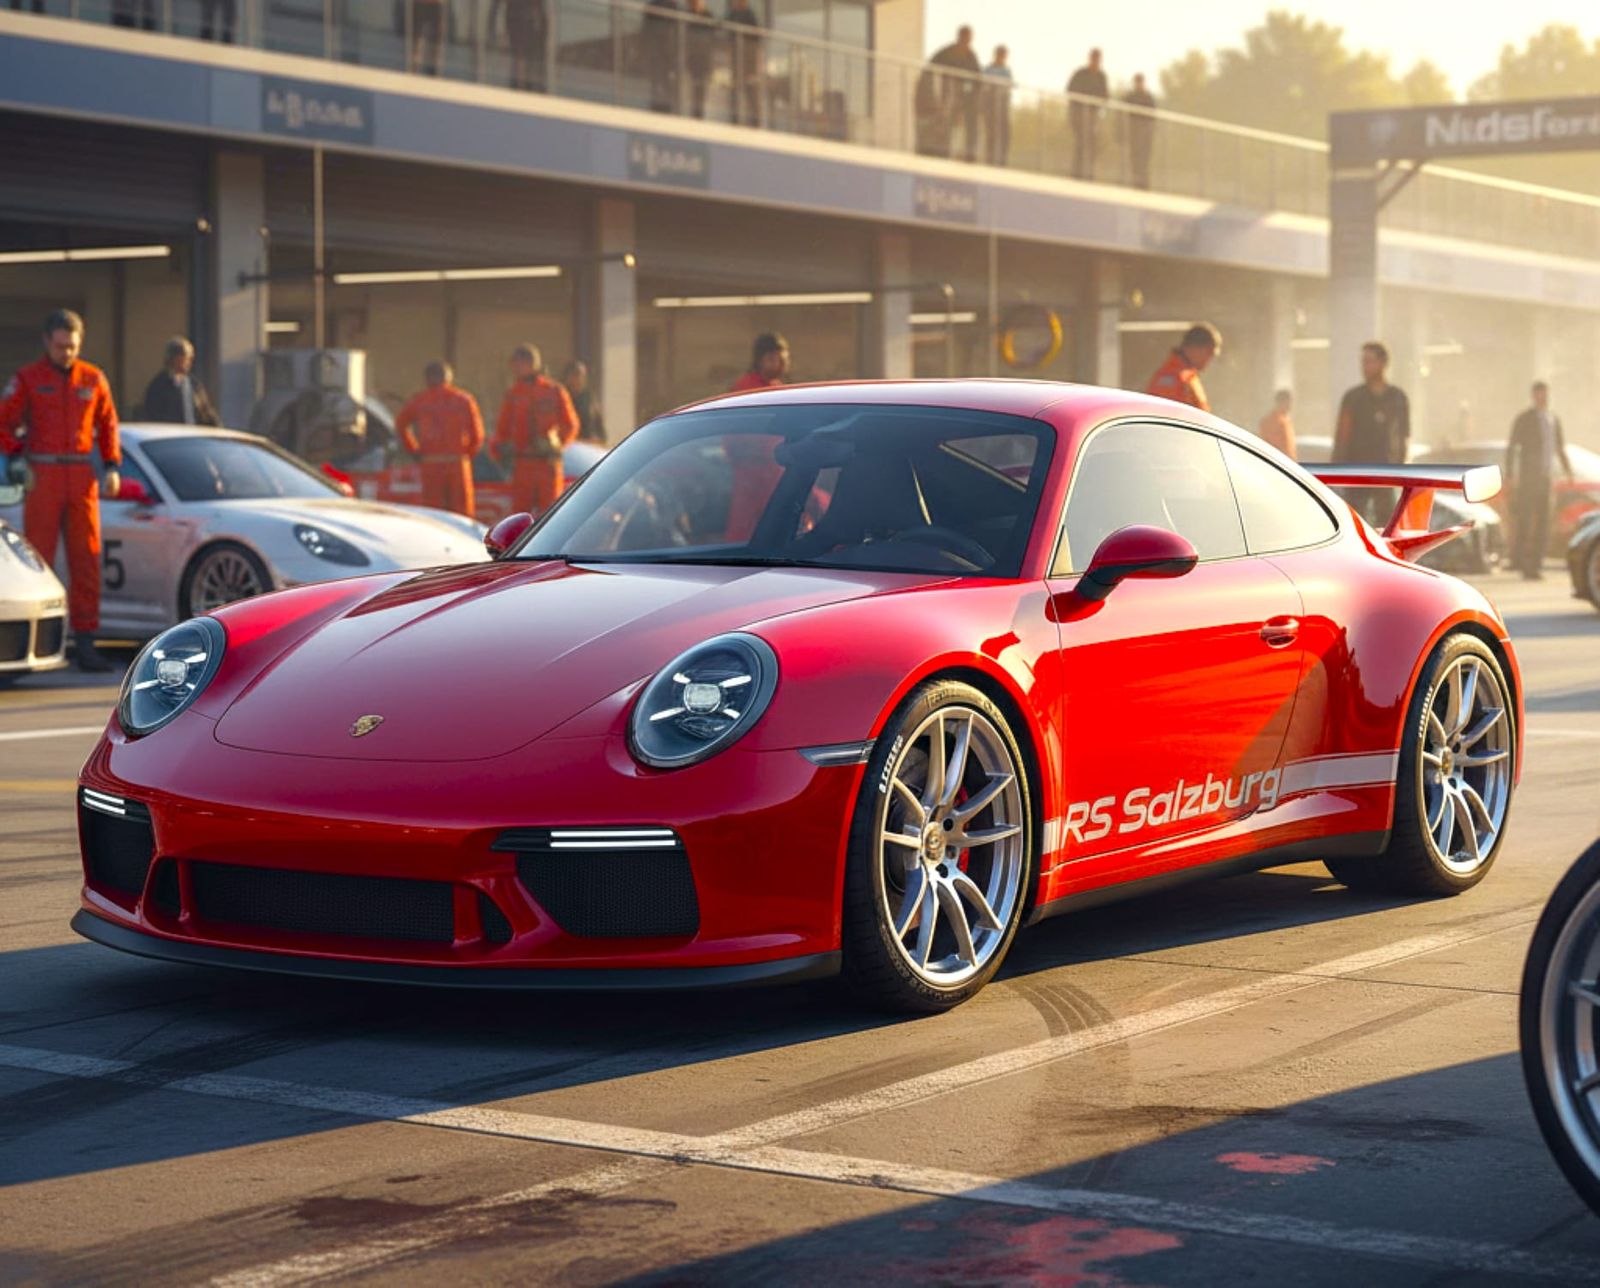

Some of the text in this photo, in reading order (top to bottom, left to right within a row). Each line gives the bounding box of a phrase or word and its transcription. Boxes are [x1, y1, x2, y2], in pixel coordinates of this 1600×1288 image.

[104, 541, 126, 590] 5
[1063, 769, 1282, 849] RS Salzburg
